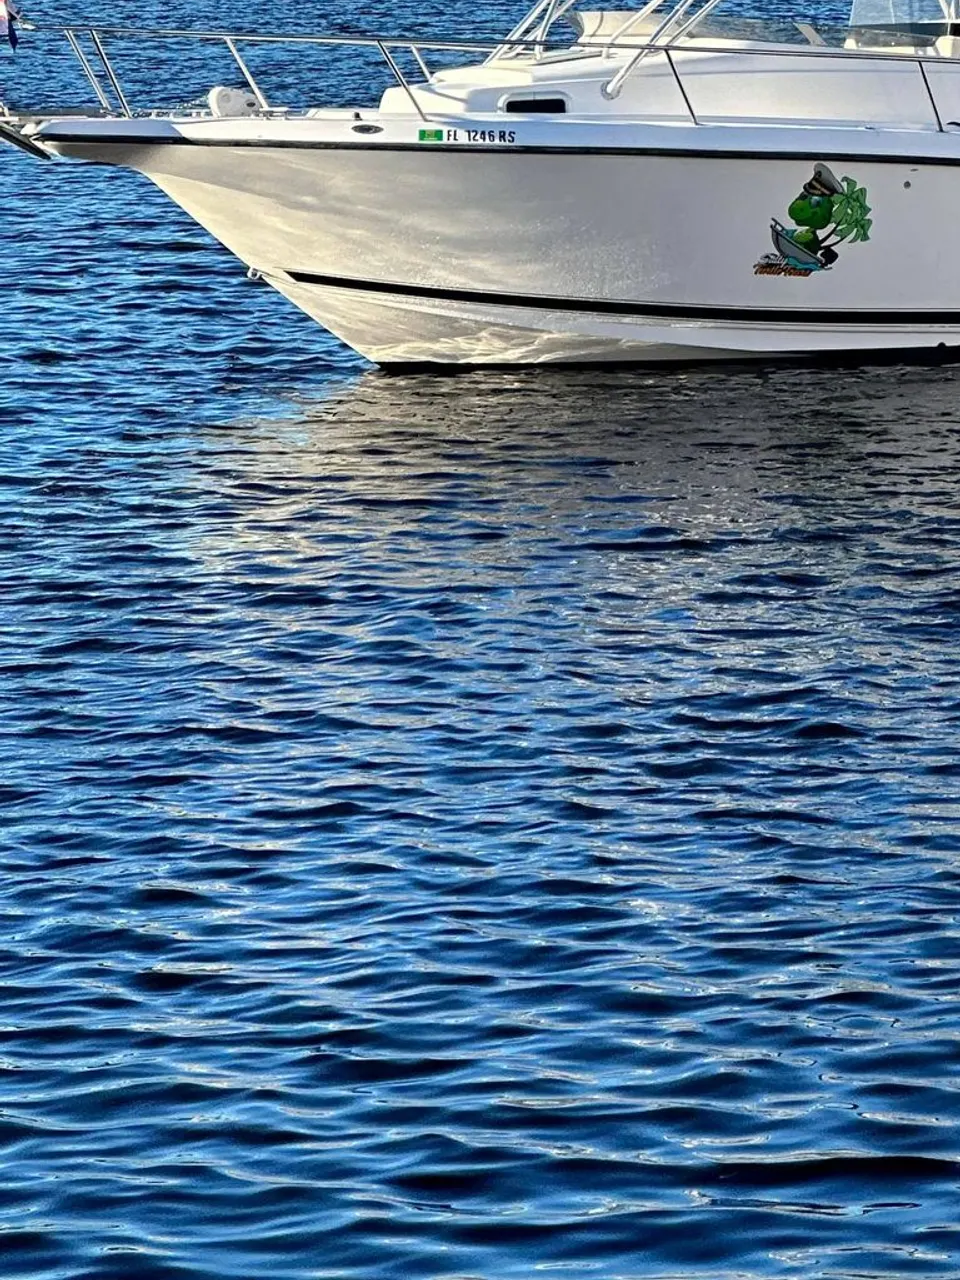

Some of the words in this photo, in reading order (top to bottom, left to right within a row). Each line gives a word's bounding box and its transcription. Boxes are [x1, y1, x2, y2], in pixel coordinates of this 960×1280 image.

[447, 129, 459, 142] FL
[465, 129, 495, 143] 1246
[498, 130, 516, 143] RS
